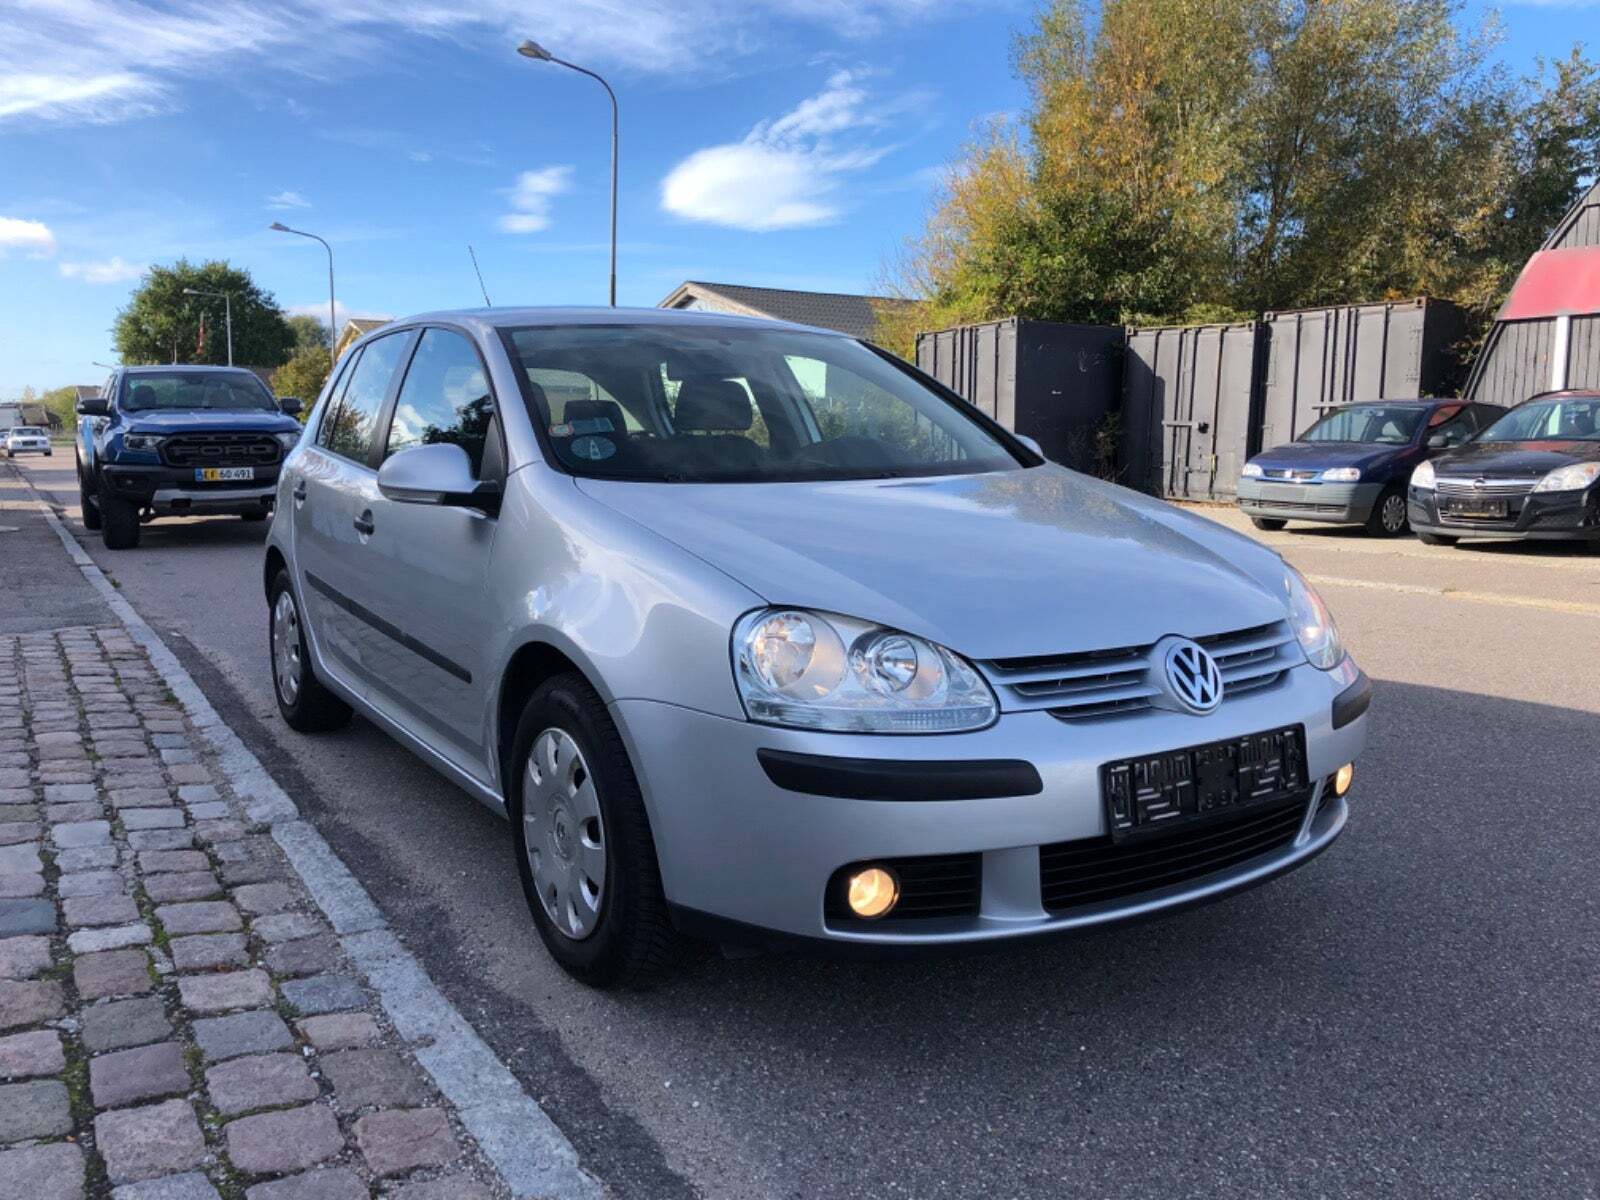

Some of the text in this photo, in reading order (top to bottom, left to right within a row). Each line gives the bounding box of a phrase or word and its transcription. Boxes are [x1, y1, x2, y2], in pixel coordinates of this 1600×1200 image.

[171, 444, 273, 456] FORD
[233, 468, 250, 478] 491
[1169, 643, 1221, 708] VW
